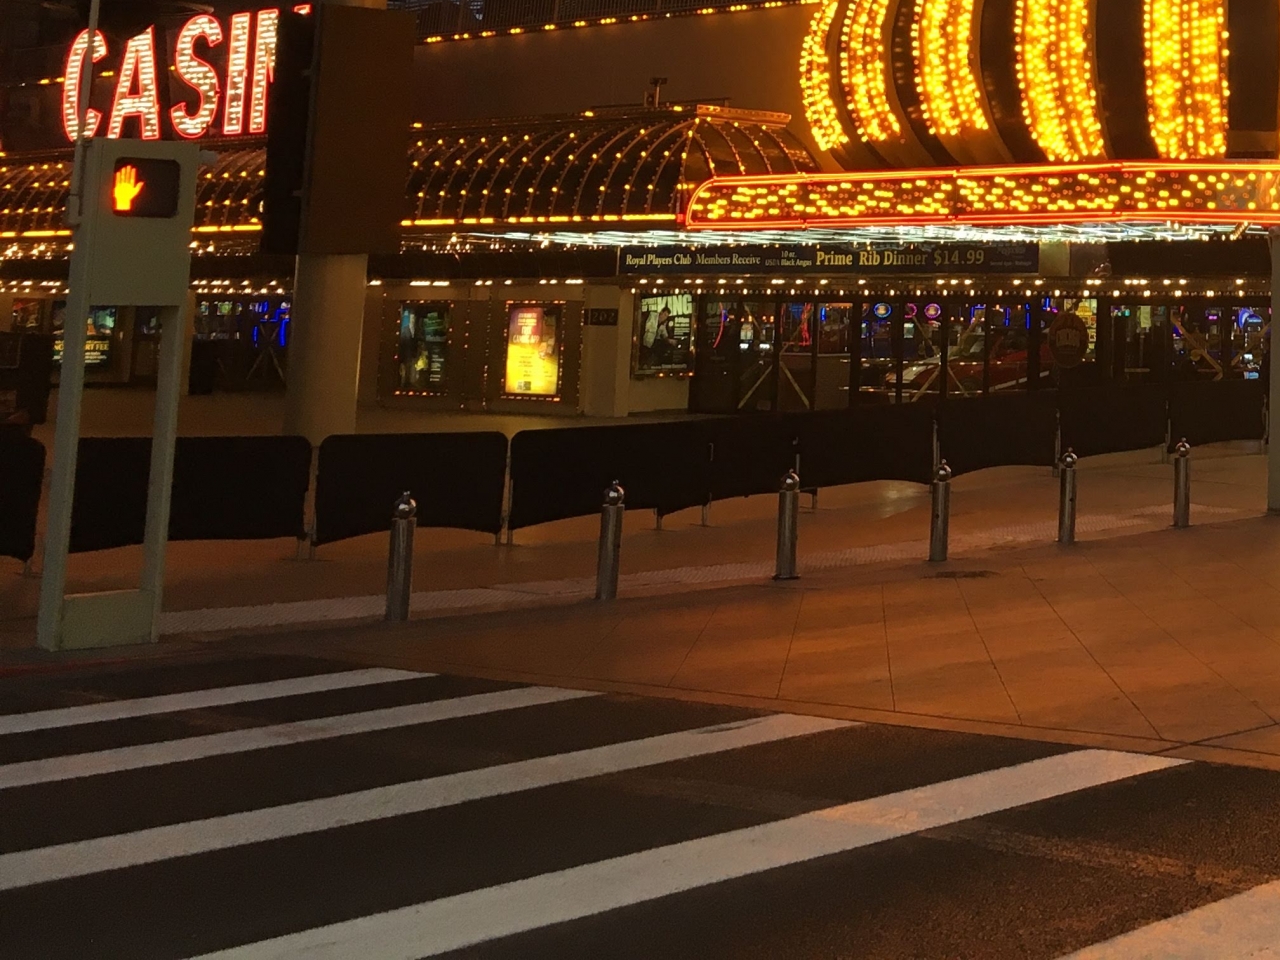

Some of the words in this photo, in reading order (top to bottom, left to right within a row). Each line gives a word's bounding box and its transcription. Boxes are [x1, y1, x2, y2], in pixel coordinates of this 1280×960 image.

[625, 253, 646, 268] Royal
[647, 253, 672, 268] Players
[673, 253, 692, 265] Club
[695, 253, 730, 265] Members
[732, 253, 761, 265] Receive
[816, 251, 853, 266] Prime
[859, 250, 881, 266] Rib
[883, 250, 928, 266] Dinner
[933, 249, 985, 267] $14.99
[657, 293, 692, 316] KING
